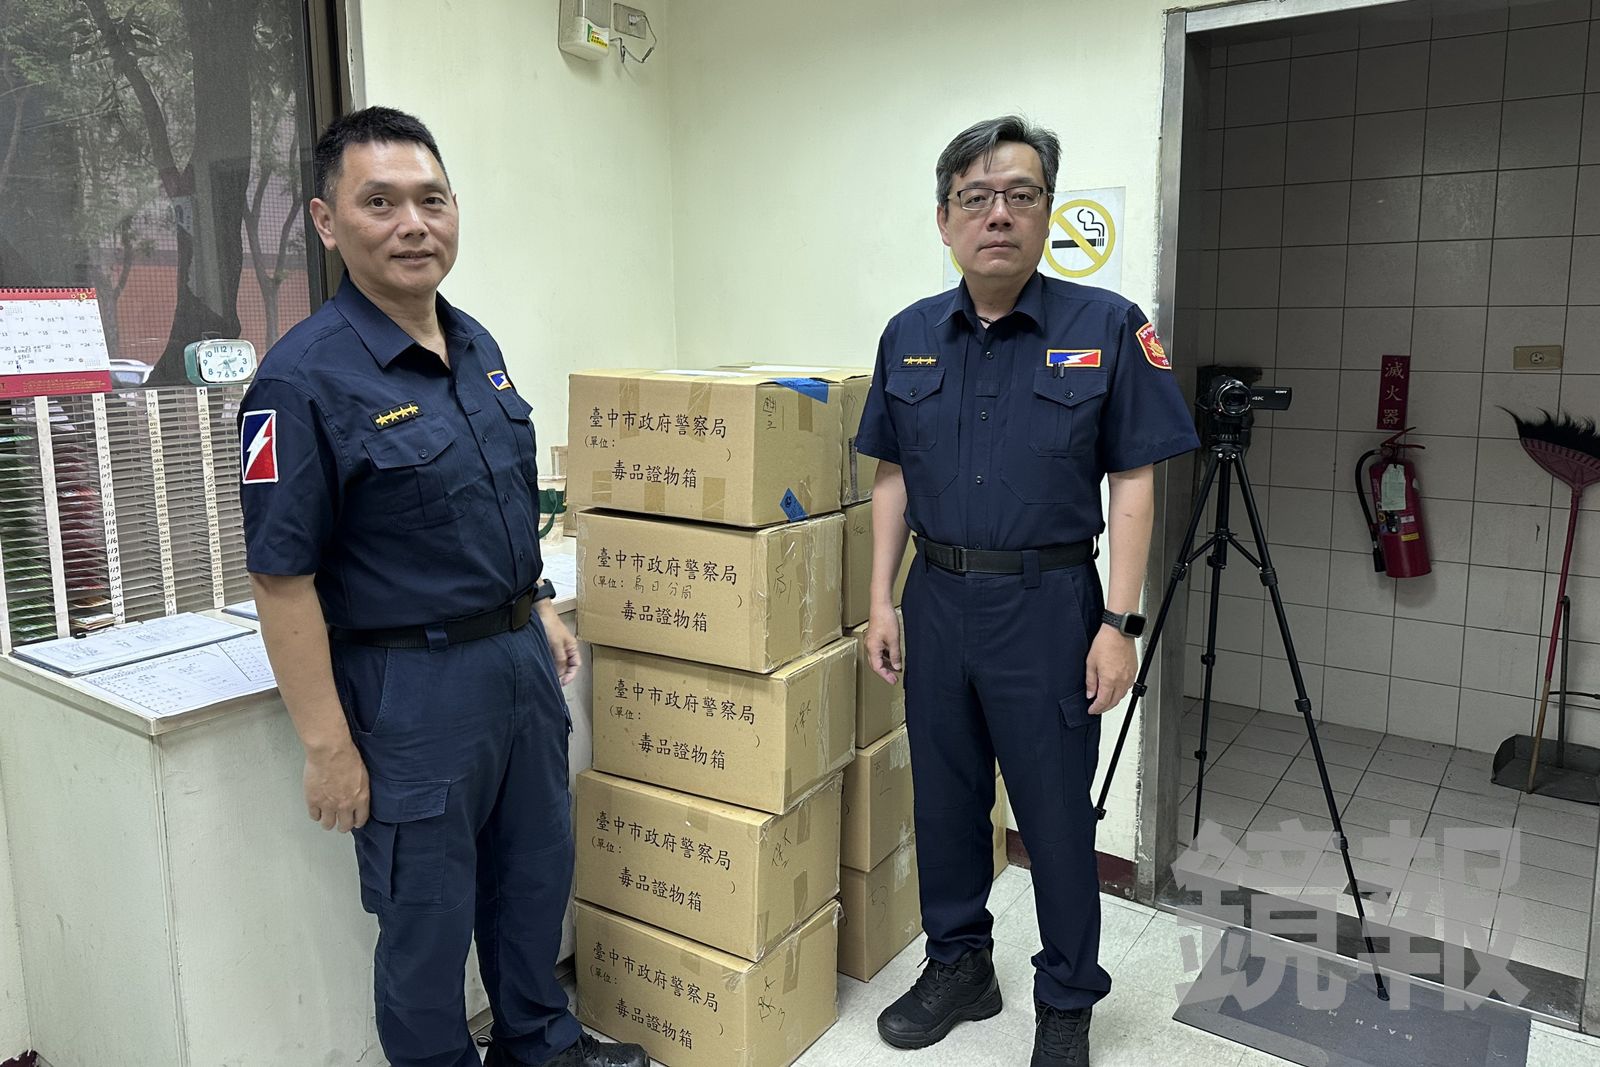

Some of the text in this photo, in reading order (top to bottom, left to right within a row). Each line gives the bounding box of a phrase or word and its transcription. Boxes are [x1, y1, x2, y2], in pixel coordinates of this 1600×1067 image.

[1383, 361, 1405, 425] 滅火器
[589, 406, 727, 438] 臺中市政府警察局
[612, 460, 697, 488] 毒品證物箱
[597, 547, 737, 585] 臺中市政府警察局
[621, 600, 707, 632] 毒品證物箱
[614, 679, 755, 725] 臺中市政府警察局
[639, 733, 726, 770] 毒品證物箱
[596, 811, 731, 871] 臺中市政府警察局
[618, 867, 702, 912] 毒品證物箱
[593, 942, 718, 1012] 臺中市政府警察局
[615, 998, 692, 1050] 毒品證物箱
